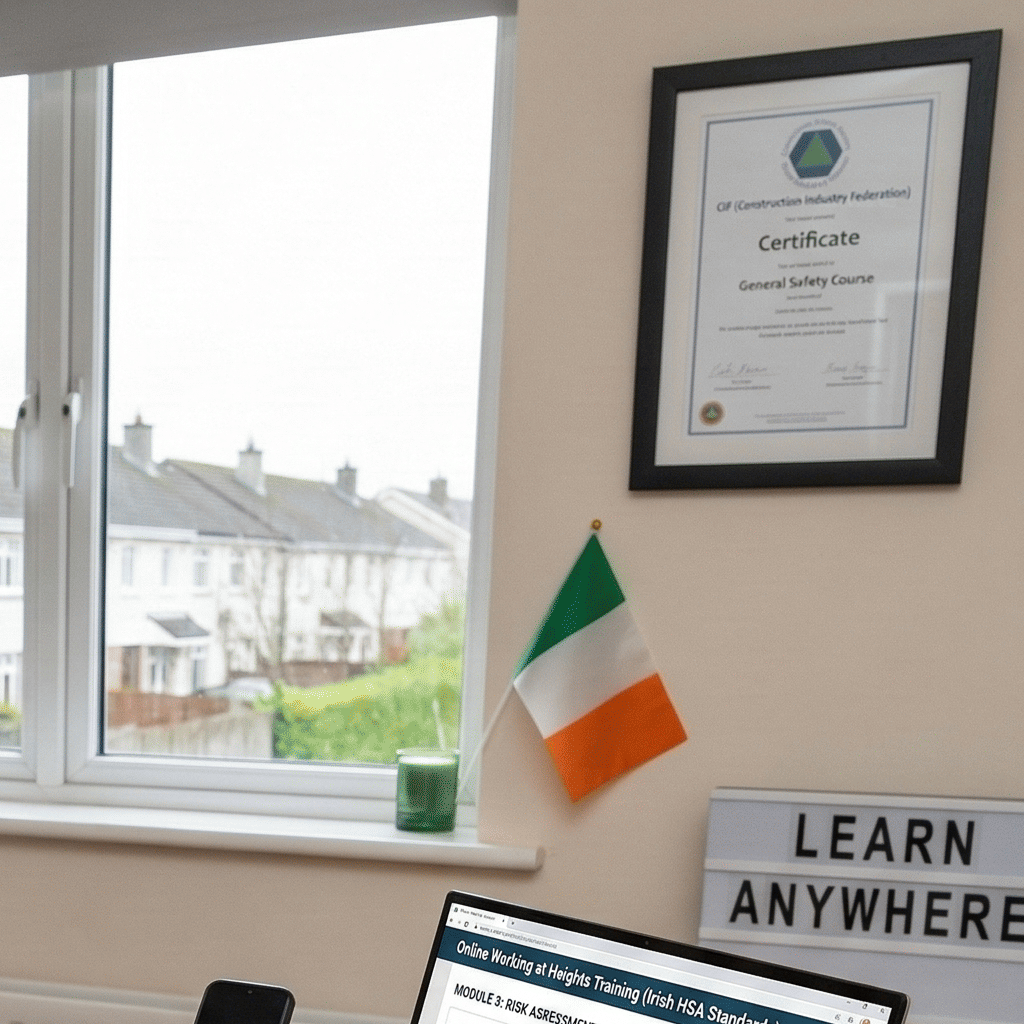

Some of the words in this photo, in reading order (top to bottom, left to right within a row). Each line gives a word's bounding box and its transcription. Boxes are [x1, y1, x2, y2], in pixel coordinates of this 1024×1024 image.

[758, 230, 861, 251] Certificate
[738, 277, 786, 291] General
[789, 275, 828, 289] Safety
[831, 273, 875, 286] Course
[795, 813, 975, 866] LEARN
[729, 880, 1024, 943] ANYWHERE
[453, 983, 494, 1006] MODULE
[494, 995, 504, 1009] 3:
[505, 998, 529, 1016] RISK
[456, 940, 488, 961] Online
[490, 947, 533, 976] Working
[535, 962, 548, 976] at
[548, 963, 591, 988] Heights
[593, 975, 640, 1005] Training
[642, 986, 675, 1011] (Irish
[676, 997, 705, 1019] HSA
